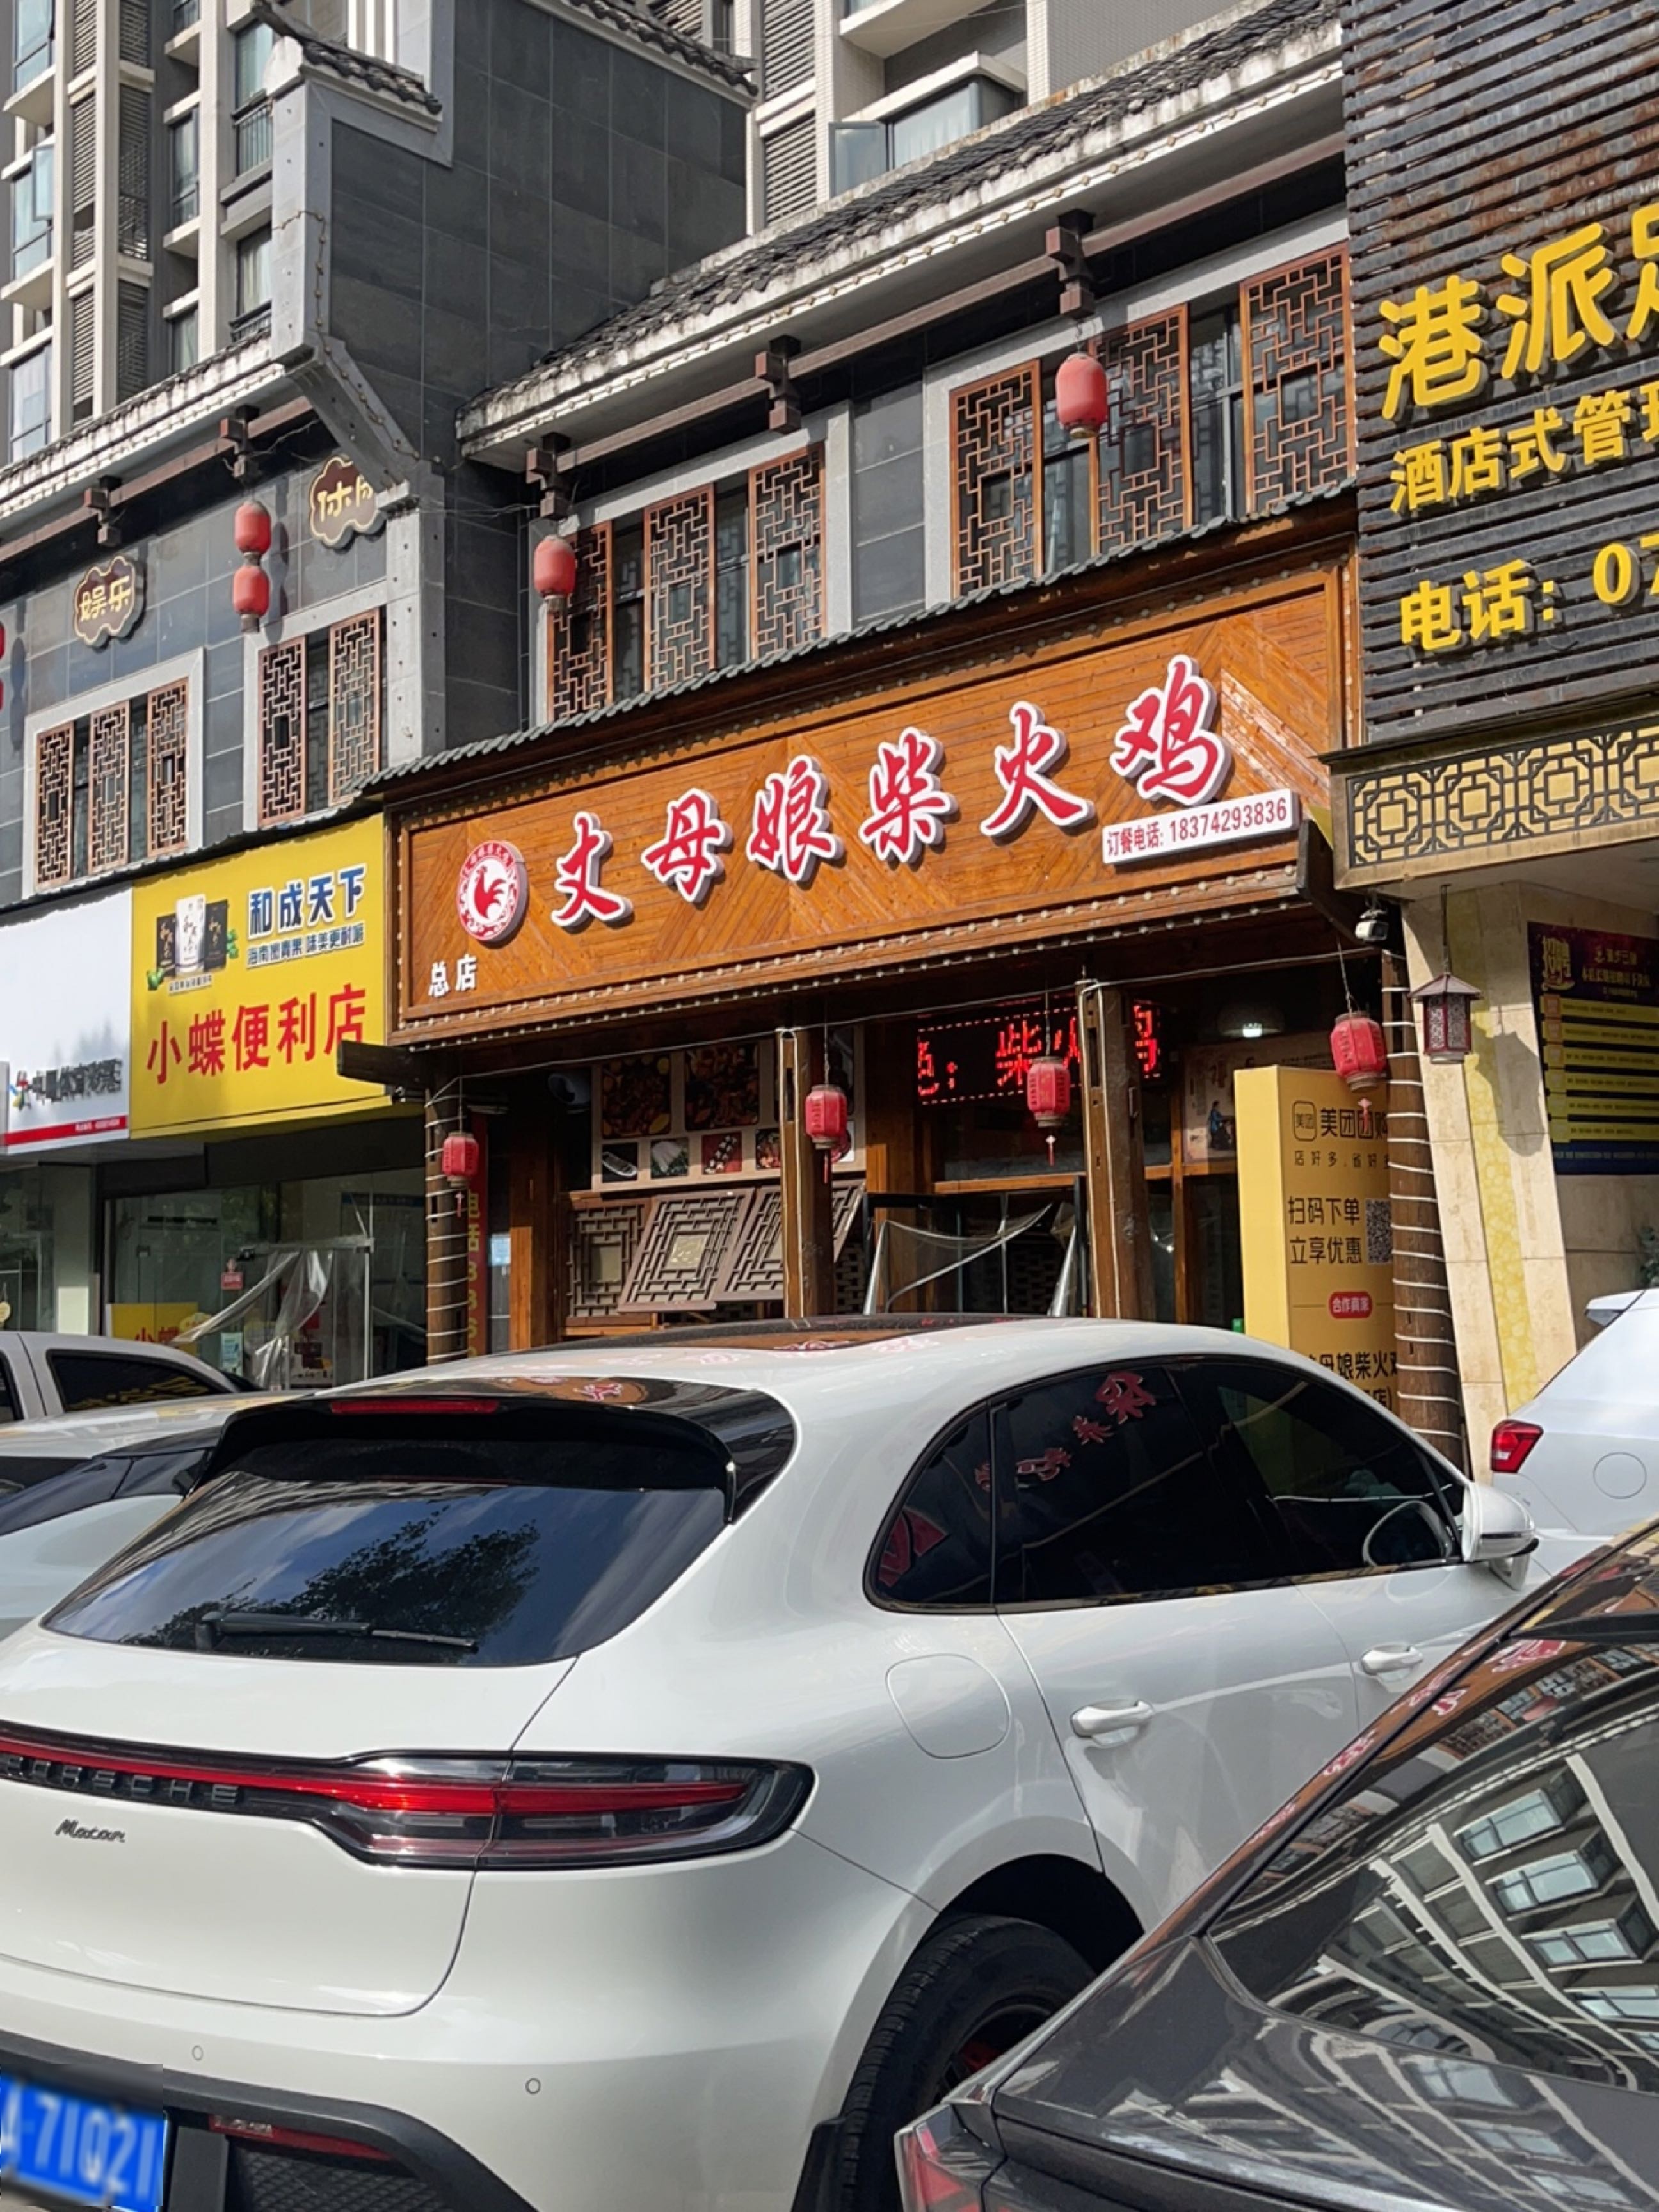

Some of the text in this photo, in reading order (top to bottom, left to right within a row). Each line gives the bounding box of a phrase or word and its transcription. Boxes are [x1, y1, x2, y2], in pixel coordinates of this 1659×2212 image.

[79, 575, 131, 621] 娱乐
[1400, 558, 1555, 650] 电话：
[552, 655, 1229, 927] 丈母娘柴火鸡
[1107, 797, 1287, 856] 订餐电话： 18374293836
[249, 864, 365, 937] 和成天下
[428, 953, 477, 997] 总店
[147, 982, 366, 1084] 小蝶便利店
[1288, 1196, 1360, 1225] 扫码下单
[1290, 1236, 1362, 1264] 立享优惠
[1332, 1297, 1370, 1313] 合作商家
[1308, 1350, 1398, 1380] 母娘柴火
[54, 1818, 125, 1843] Macan
